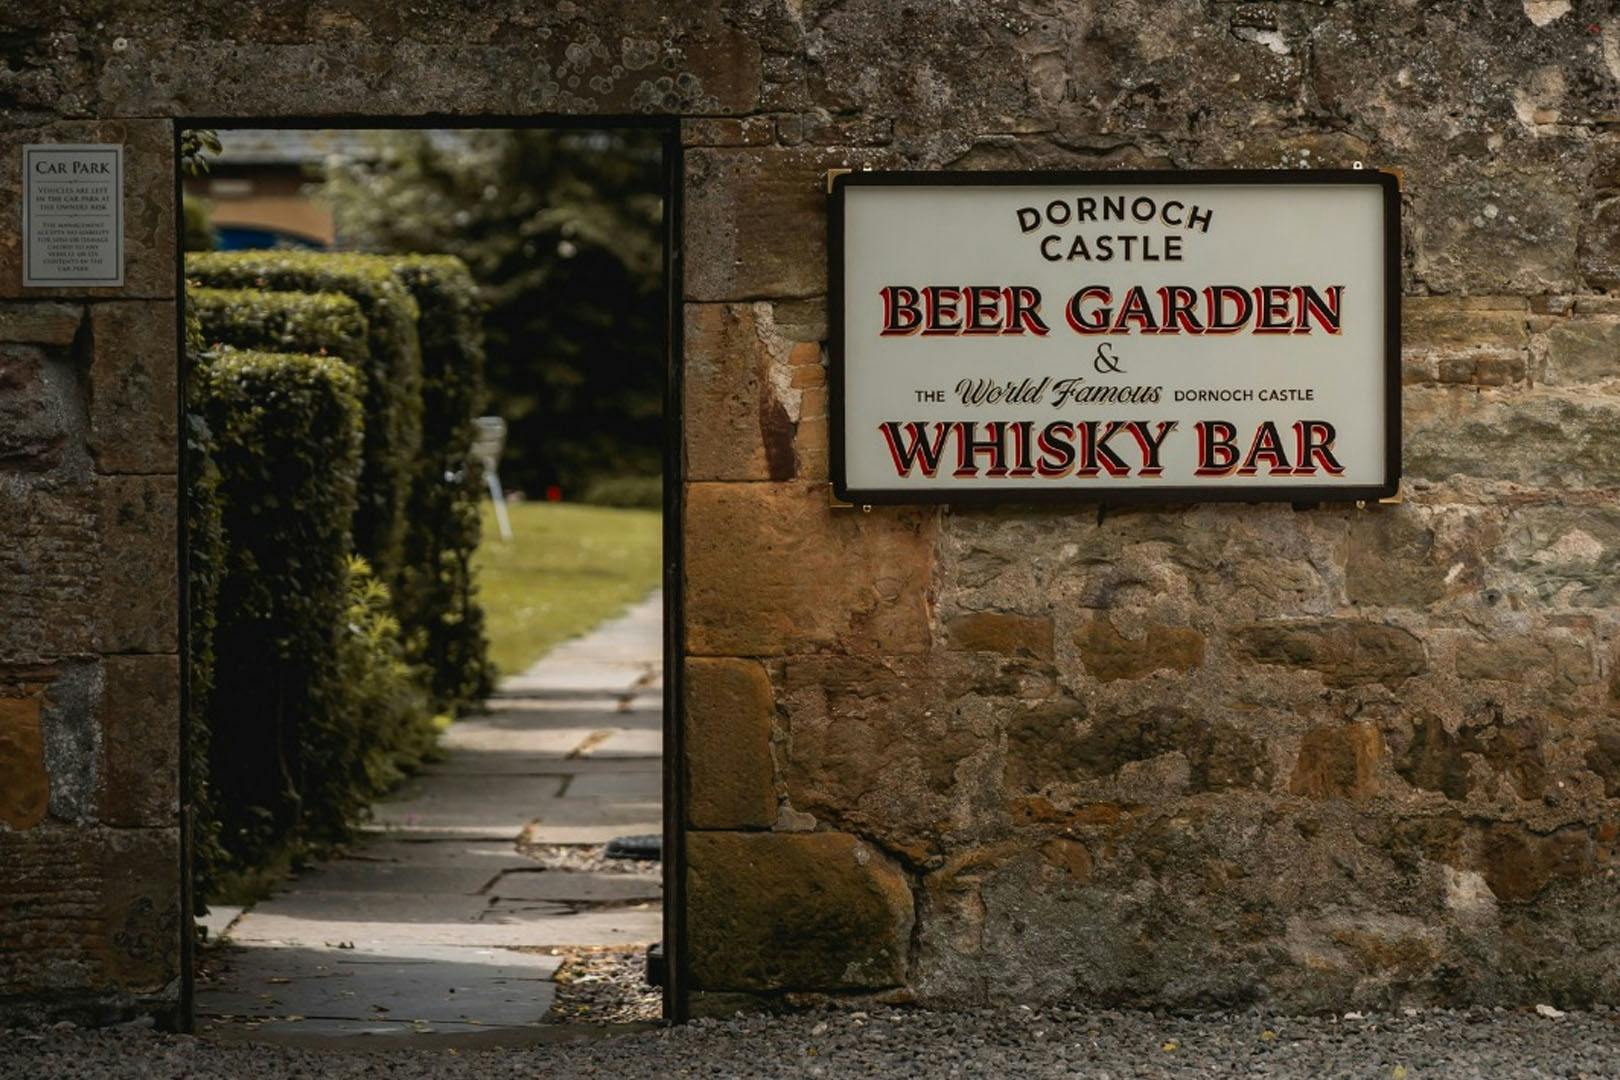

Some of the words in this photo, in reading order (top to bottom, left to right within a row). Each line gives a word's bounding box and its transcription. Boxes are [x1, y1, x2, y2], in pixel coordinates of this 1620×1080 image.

[35, 161, 67, 175] CAR
[72, 161, 110, 175] PARK
[1016, 196, 1213, 233] DORNOCH
[1040, 234, 1184, 262] CASTLE
[879, 285, 1051, 336] BEER
[1064, 285, 1346, 336] GARDEN
[1093, 342, 1128, 374] &
[914, 389, 945, 403] THE
[954, 377, 1048, 406] World
[1051, 377, 1163, 408] Famous
[1173, 389, 1254, 403] DORNOCH
[1258, 388, 1314, 402] CASTLE
[878, 420, 1178, 478] WHISKY
[1193, 420, 1346, 478] BAR
